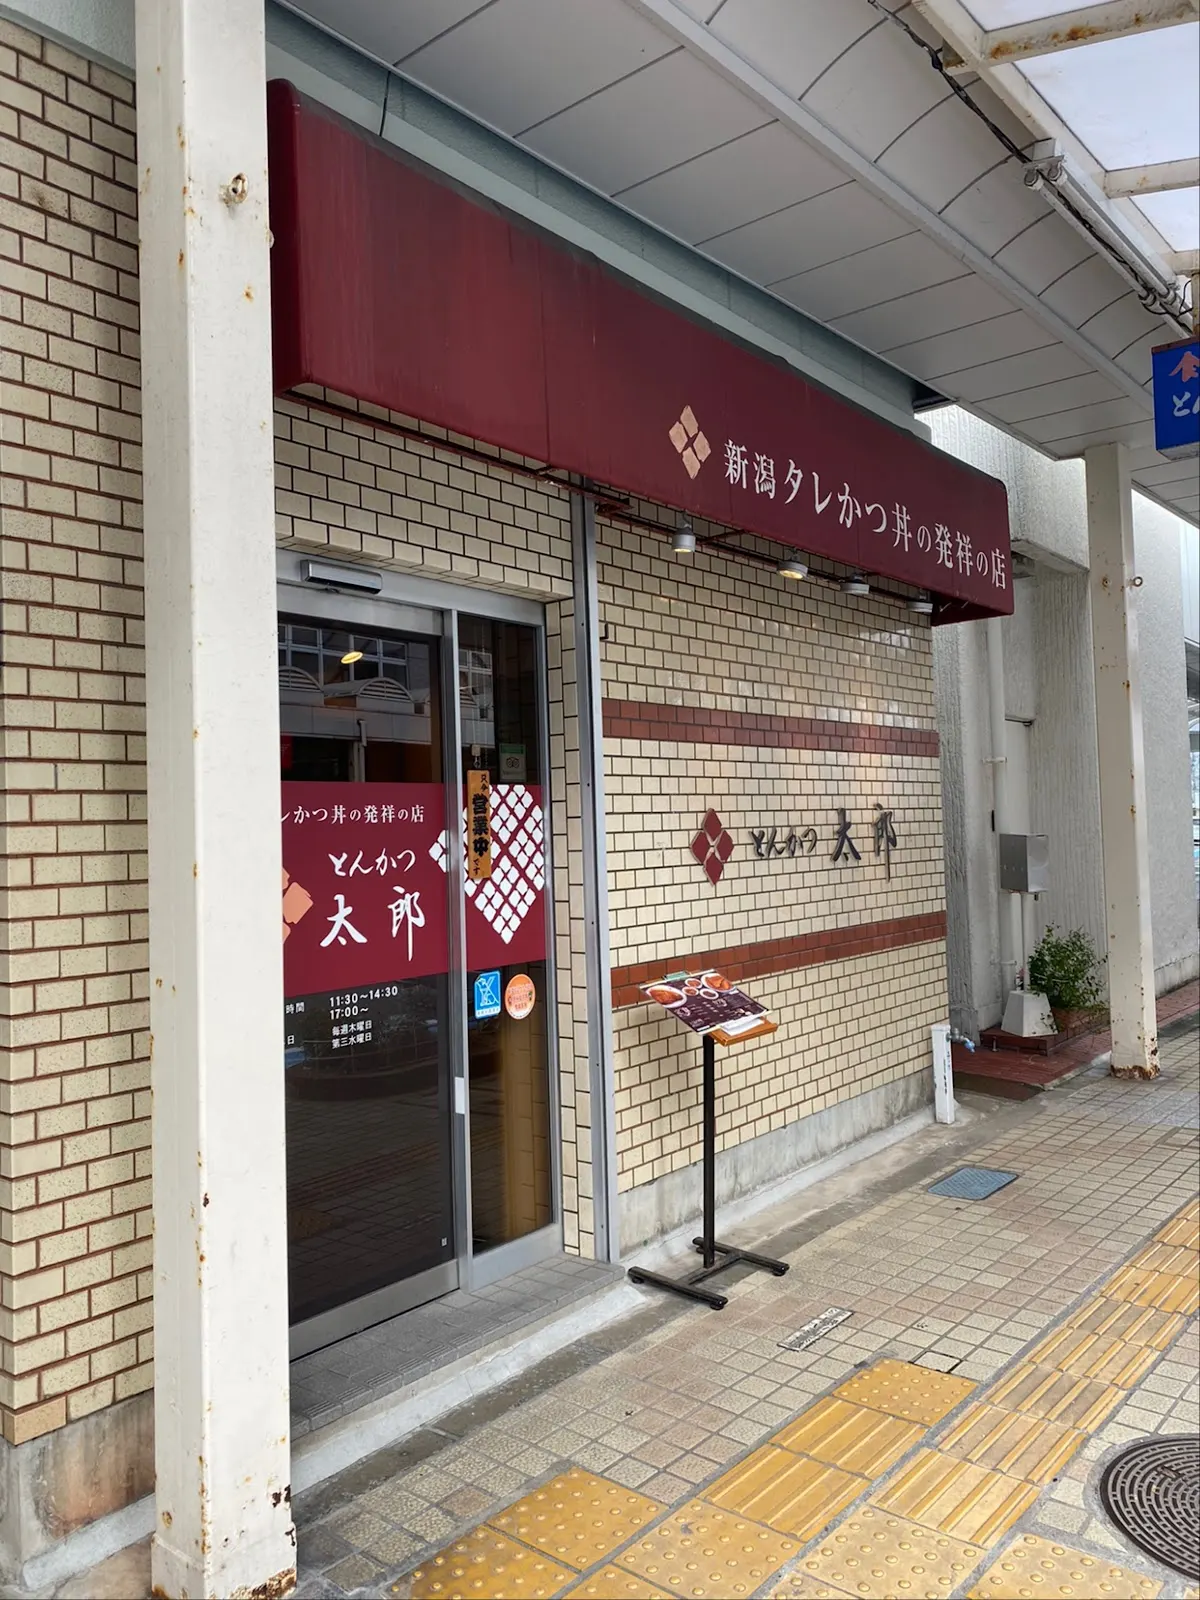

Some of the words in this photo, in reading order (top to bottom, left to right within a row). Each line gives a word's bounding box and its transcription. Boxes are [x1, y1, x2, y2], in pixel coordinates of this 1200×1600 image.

[724, 438, 1007, 590] 新潟タレかつ丼の発祥の店
[328, 848, 416, 877] とんかつ
[748, 827, 818, 859] とんかつ
[830, 803, 898, 884] 太郎
[320, 885, 426, 962] 太郎
[332, 1020, 372, 1036] 毎週木曜日
[332, 1032, 372, 1049] 第三水曜日
